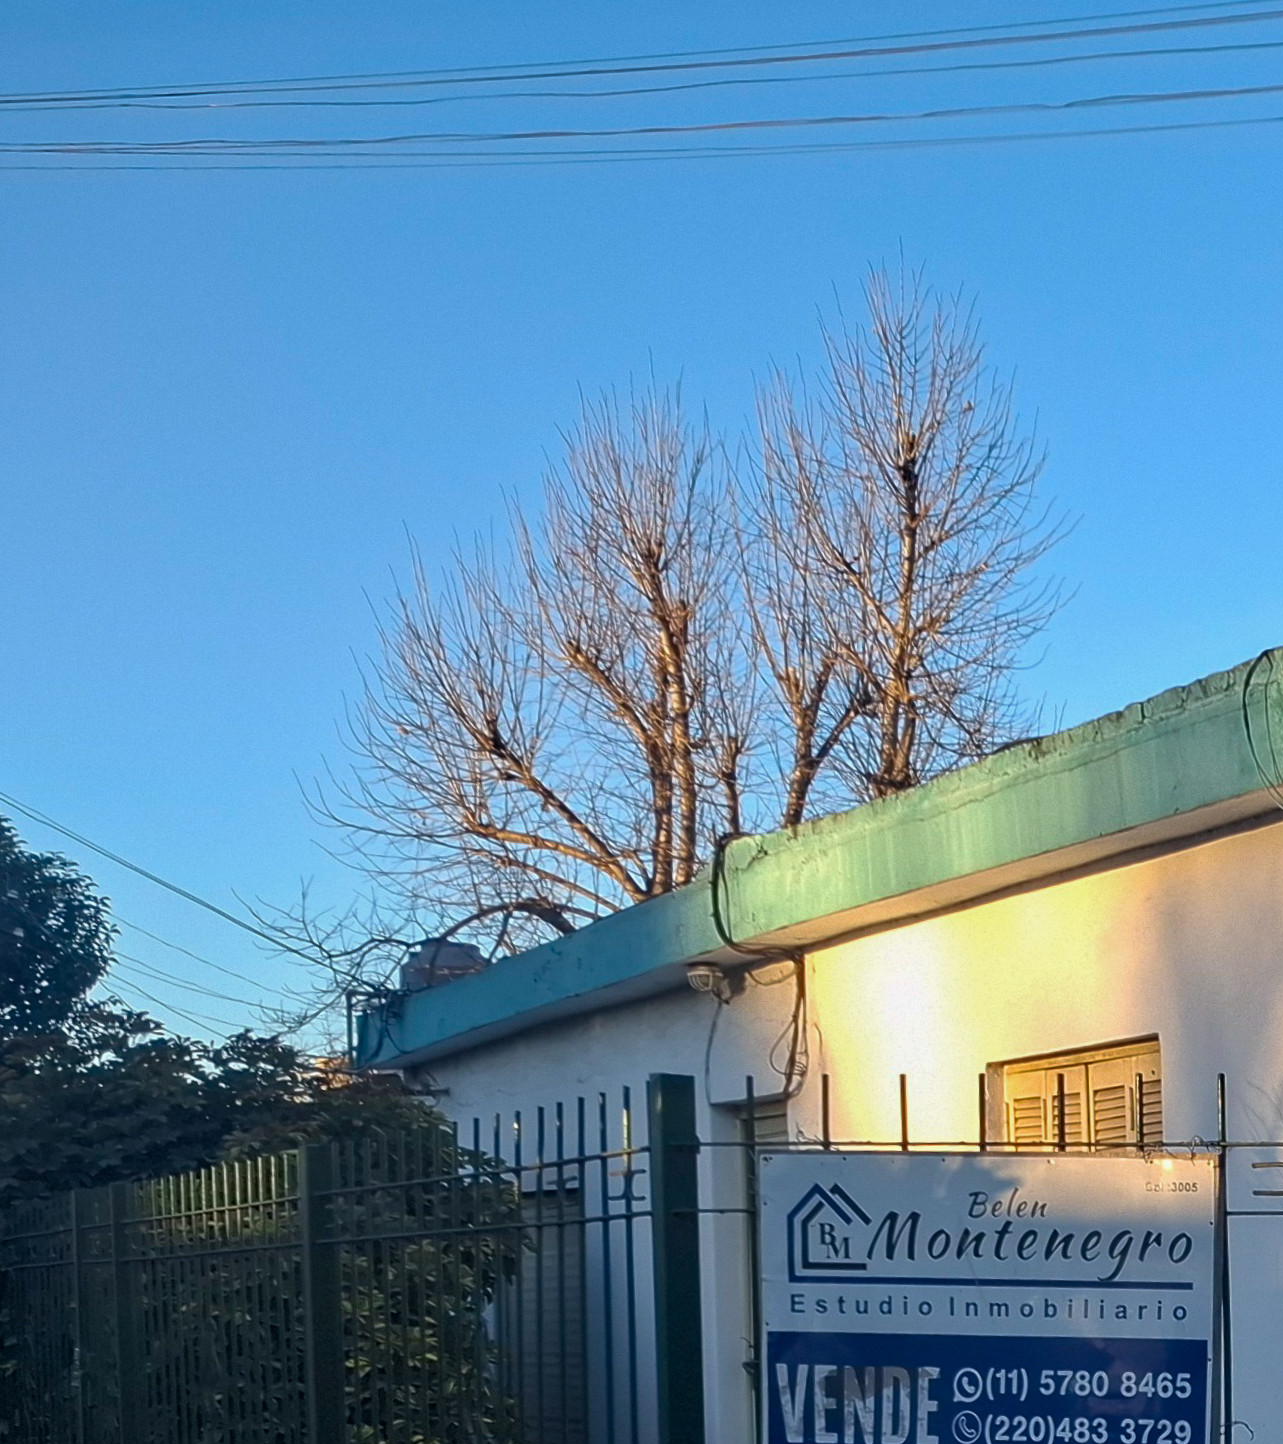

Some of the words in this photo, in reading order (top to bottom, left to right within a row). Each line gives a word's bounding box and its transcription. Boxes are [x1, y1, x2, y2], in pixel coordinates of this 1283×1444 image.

[968, 1187, 1048, 1219] Belen
[866, 1210, 1193, 1281] Montenegro
[790, 1293, 933, 1316] Estudio
[949, 1296, 1188, 1321] Inmobiliario
[986, 1367, 1029, 1401] (11)
[1039, 1369, 1109, 1397] 5780
[1120, 1371, 1192, 1399] 8465
